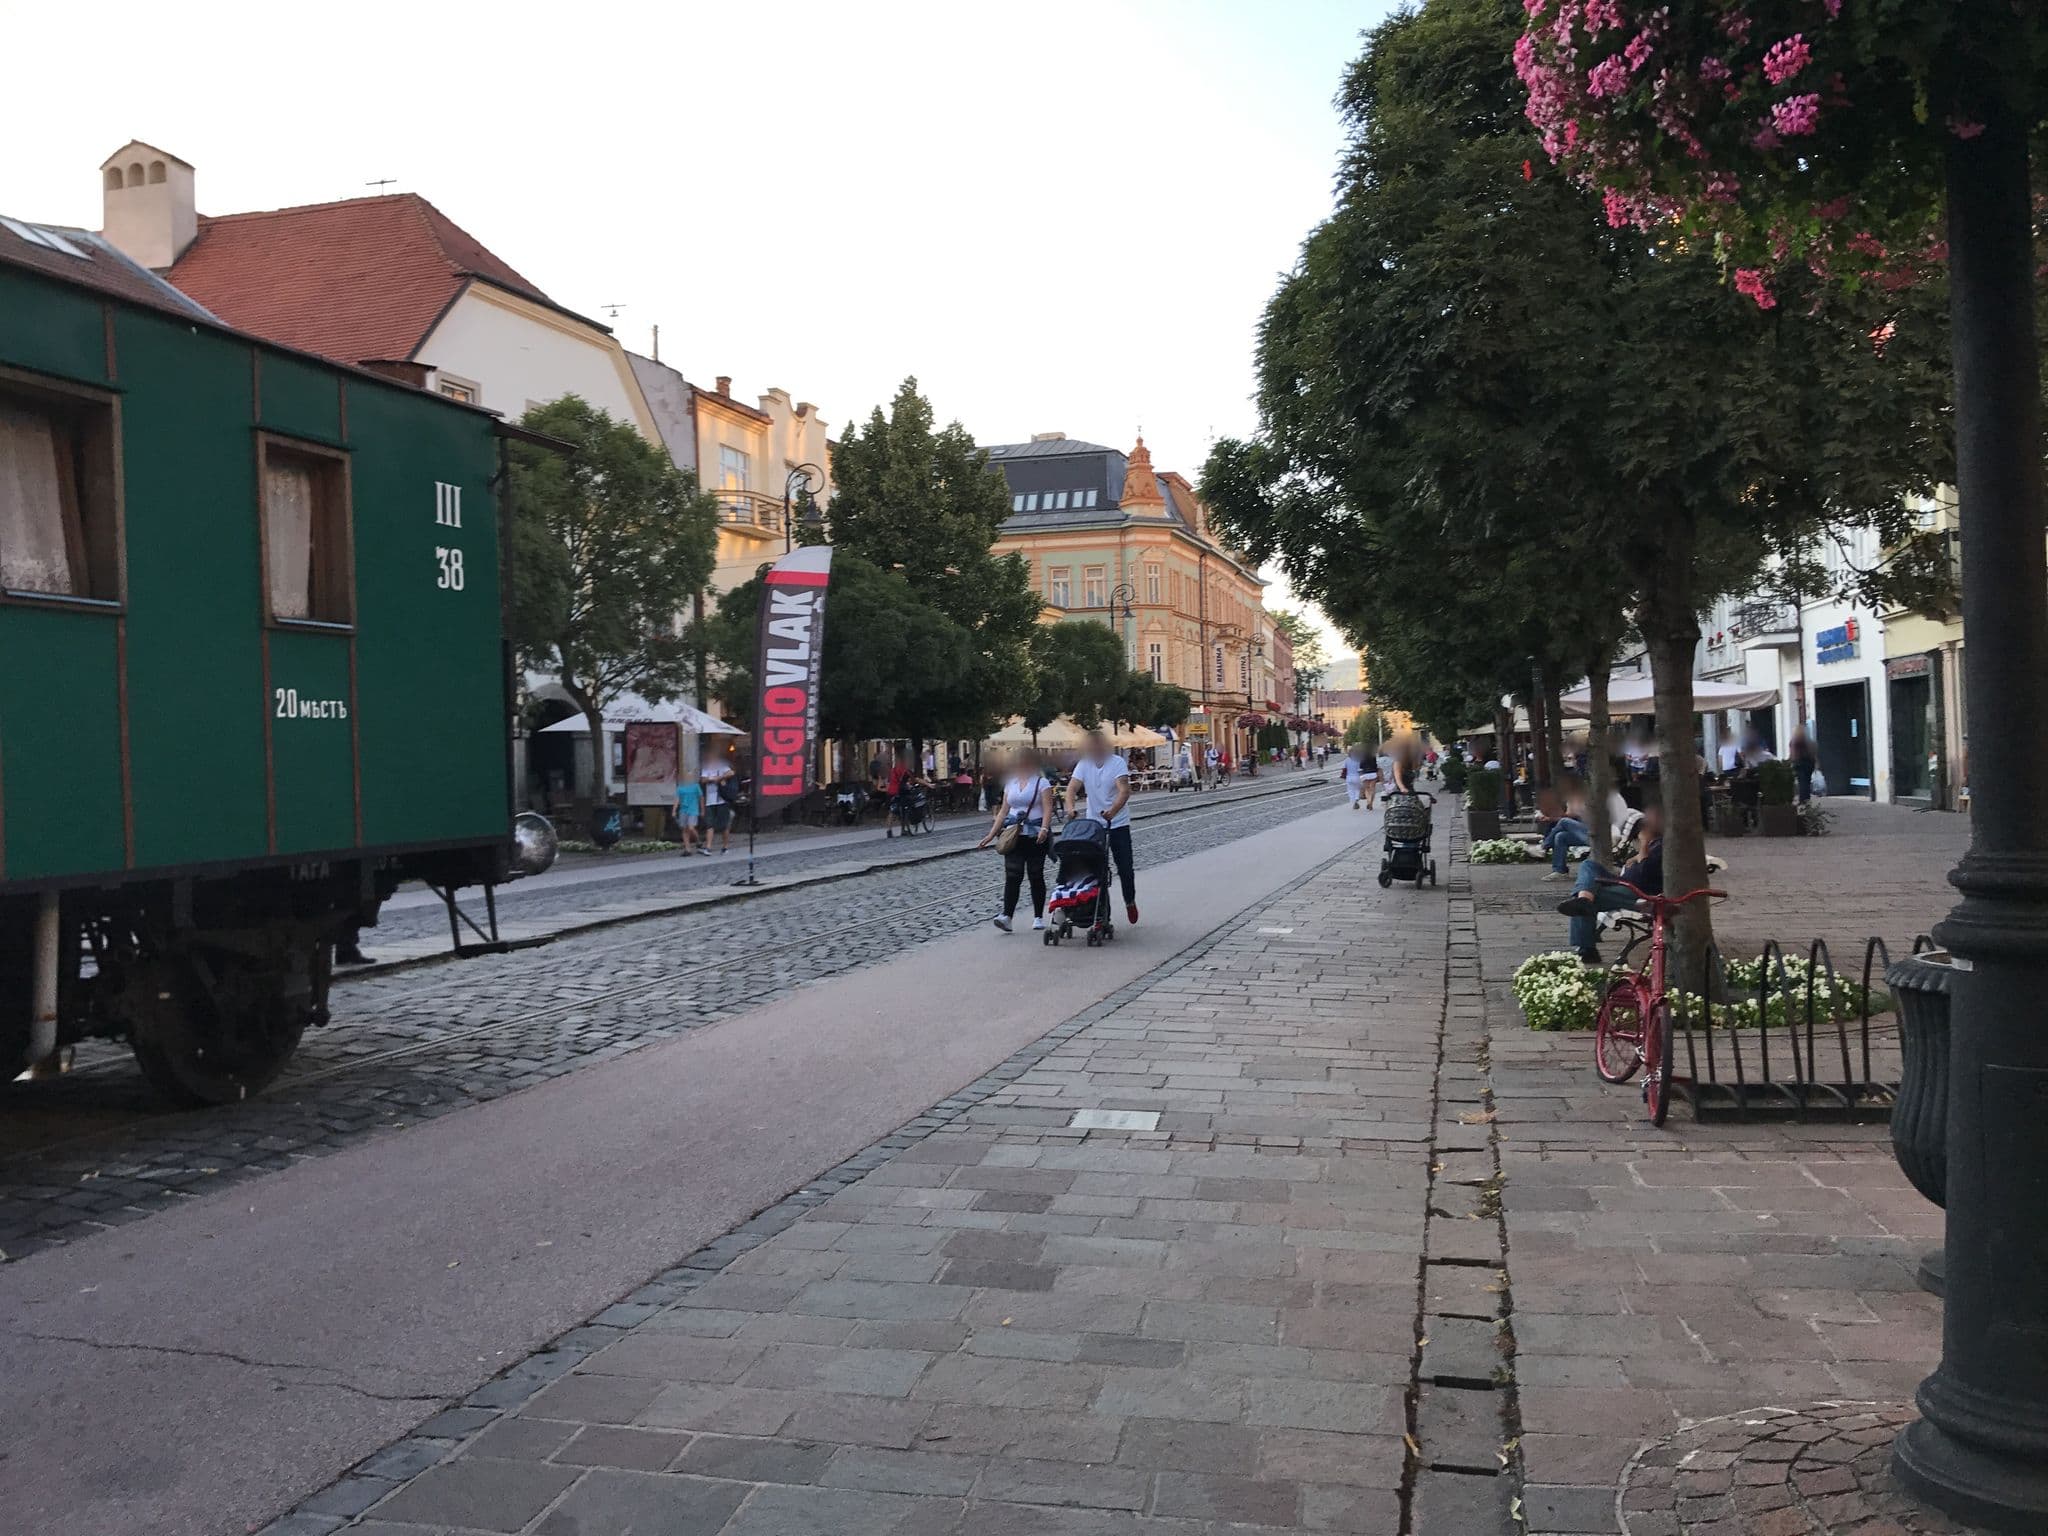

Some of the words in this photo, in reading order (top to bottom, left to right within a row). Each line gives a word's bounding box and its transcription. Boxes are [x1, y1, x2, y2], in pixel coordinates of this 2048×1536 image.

[434, 481, 463, 529] III
[435, 545, 465, 592] 38
[275, 687, 298, 719] 20
[762, 589, 814, 796] LEGIOVLAK
